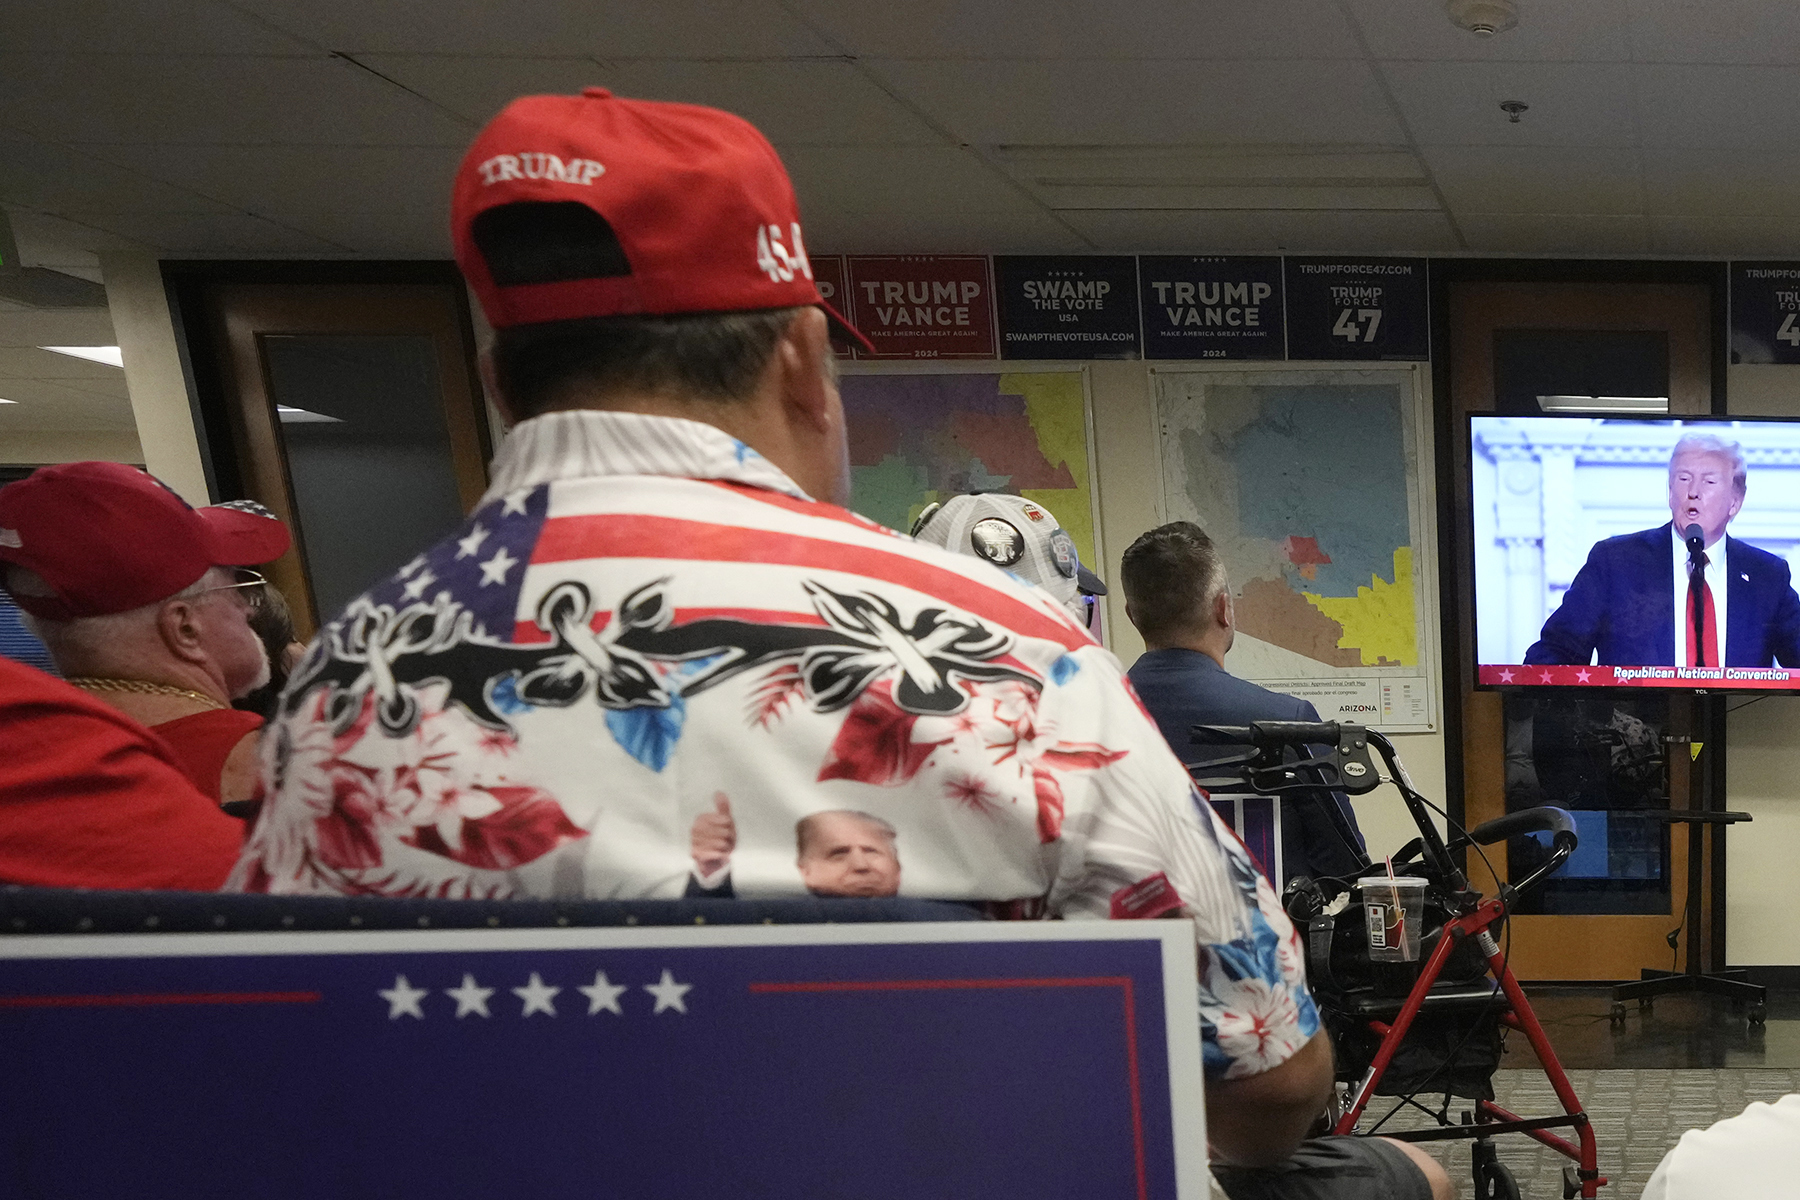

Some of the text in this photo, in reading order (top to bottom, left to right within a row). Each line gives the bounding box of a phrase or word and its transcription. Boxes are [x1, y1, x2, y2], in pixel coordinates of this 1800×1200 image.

[477, 152, 606, 186] TRUMP
[1300, 265, 1412, 275] TRUMPFORCE47.COM
[861, 281, 980, 305] TRUMP
[1023, 281, 1110, 299] SWAMP
[1152, 282, 1272, 305] TRUMP
[1330, 287, 1382, 298] TRUMP
[1032, 300, 1103, 310] THE VOTE
[1335, 298, 1378, 306] FORCE
[876, 307, 970, 326] VANCE
[1058, 314, 1079, 322] USA
[1167, 307, 1260, 326] VANCE
[1332, 308, 1383, 342] 47
[1006, 333, 1134, 342] SWAMPTHEVOTEUSA.COM
[1613, 666, 1789, 681] Republican National Convention
[1339, 704, 1377, 712] ARIZONA
